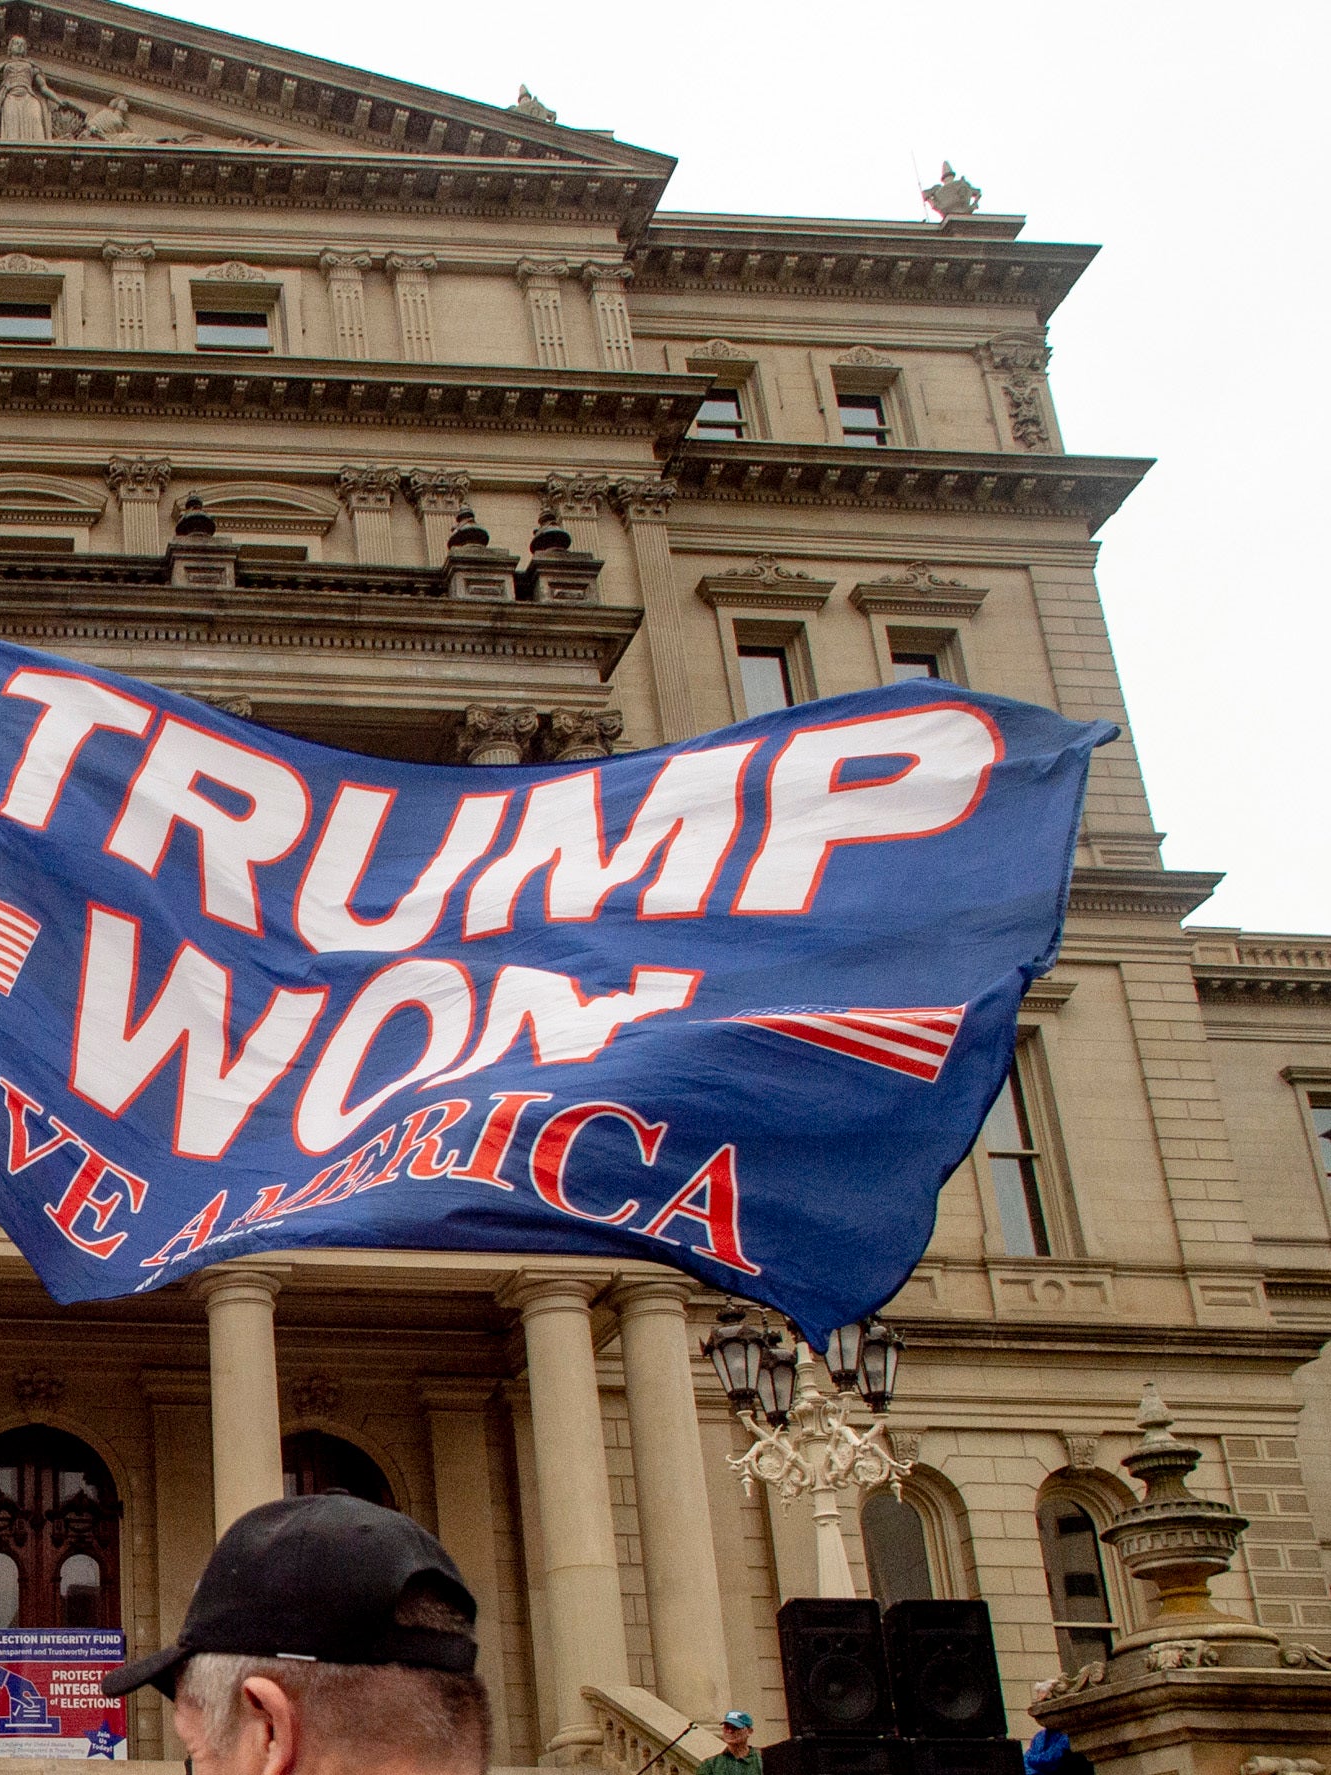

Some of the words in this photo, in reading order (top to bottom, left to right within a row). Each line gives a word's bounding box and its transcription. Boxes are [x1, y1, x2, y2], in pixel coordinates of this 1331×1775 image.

[67, 901, 703, 1160] WON
[139, 1090, 762, 1277] AMERICA
[40, 1635, 91, 1644] INTEGRITY
[93, 1635, 121, 1644] FUND
[33, 1648, 47, 1656] and
[48, 1648, 89, 1657] Trustworthy
[90, 1648, 121, 1656] Elections
[52, 1670, 103, 1680] PROTECT
[50, 1698, 58, 1706] of
[60, 1698, 121, 1709] ELECTIONS
[97, 1731, 110, 1739] Join
[92, 1743, 113, 1753] Today!
